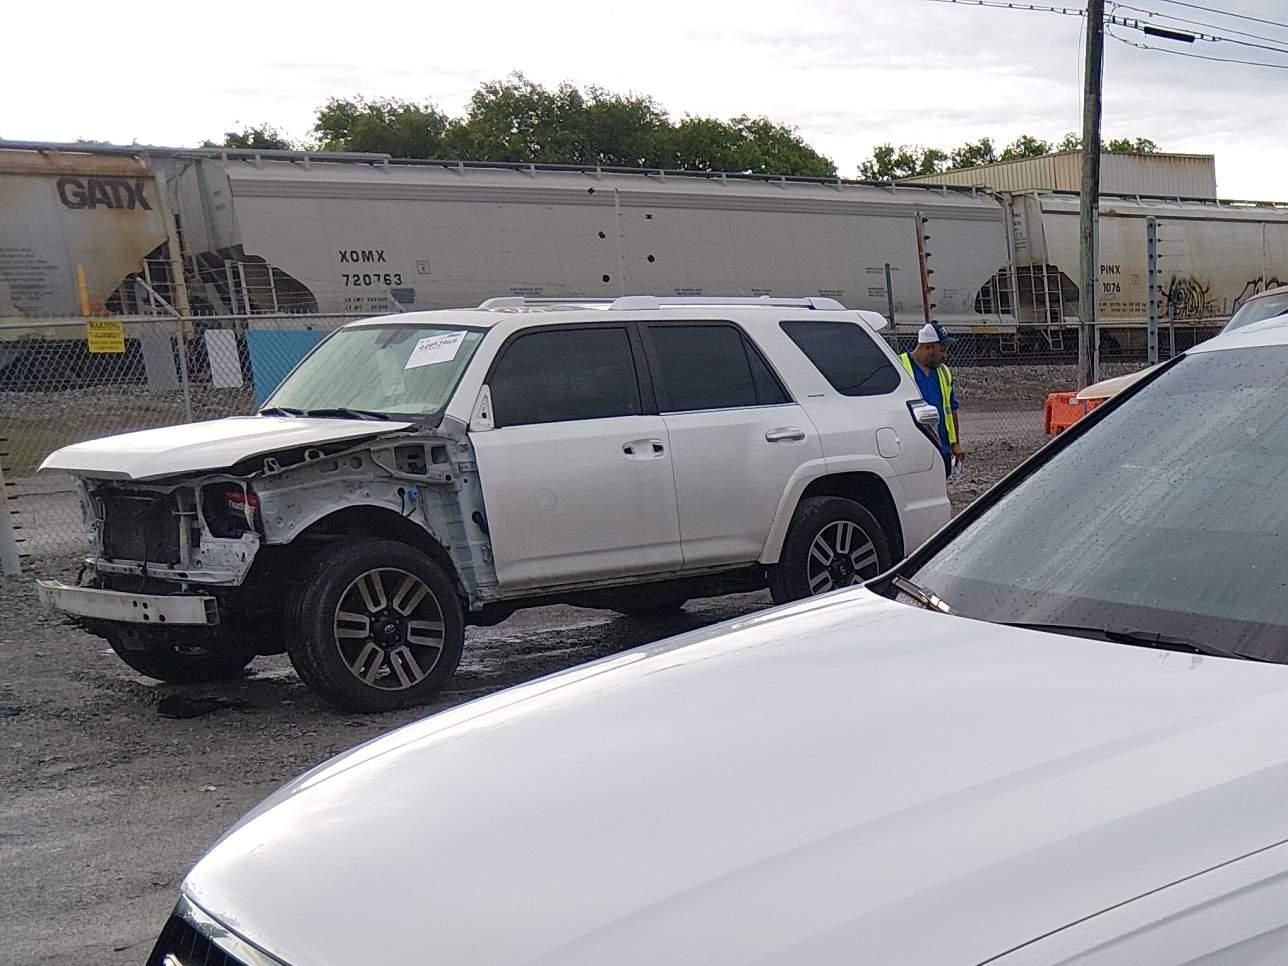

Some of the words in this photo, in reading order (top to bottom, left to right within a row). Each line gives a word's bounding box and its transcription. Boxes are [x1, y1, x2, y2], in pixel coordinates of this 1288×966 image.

[56, 177, 152, 210] GATX
[339, 250, 386, 263] XOMX
[1100, 264, 1121, 275] PINX
[342, 273, 402, 287] 720763
[1103, 282, 1121, 293] 1076
